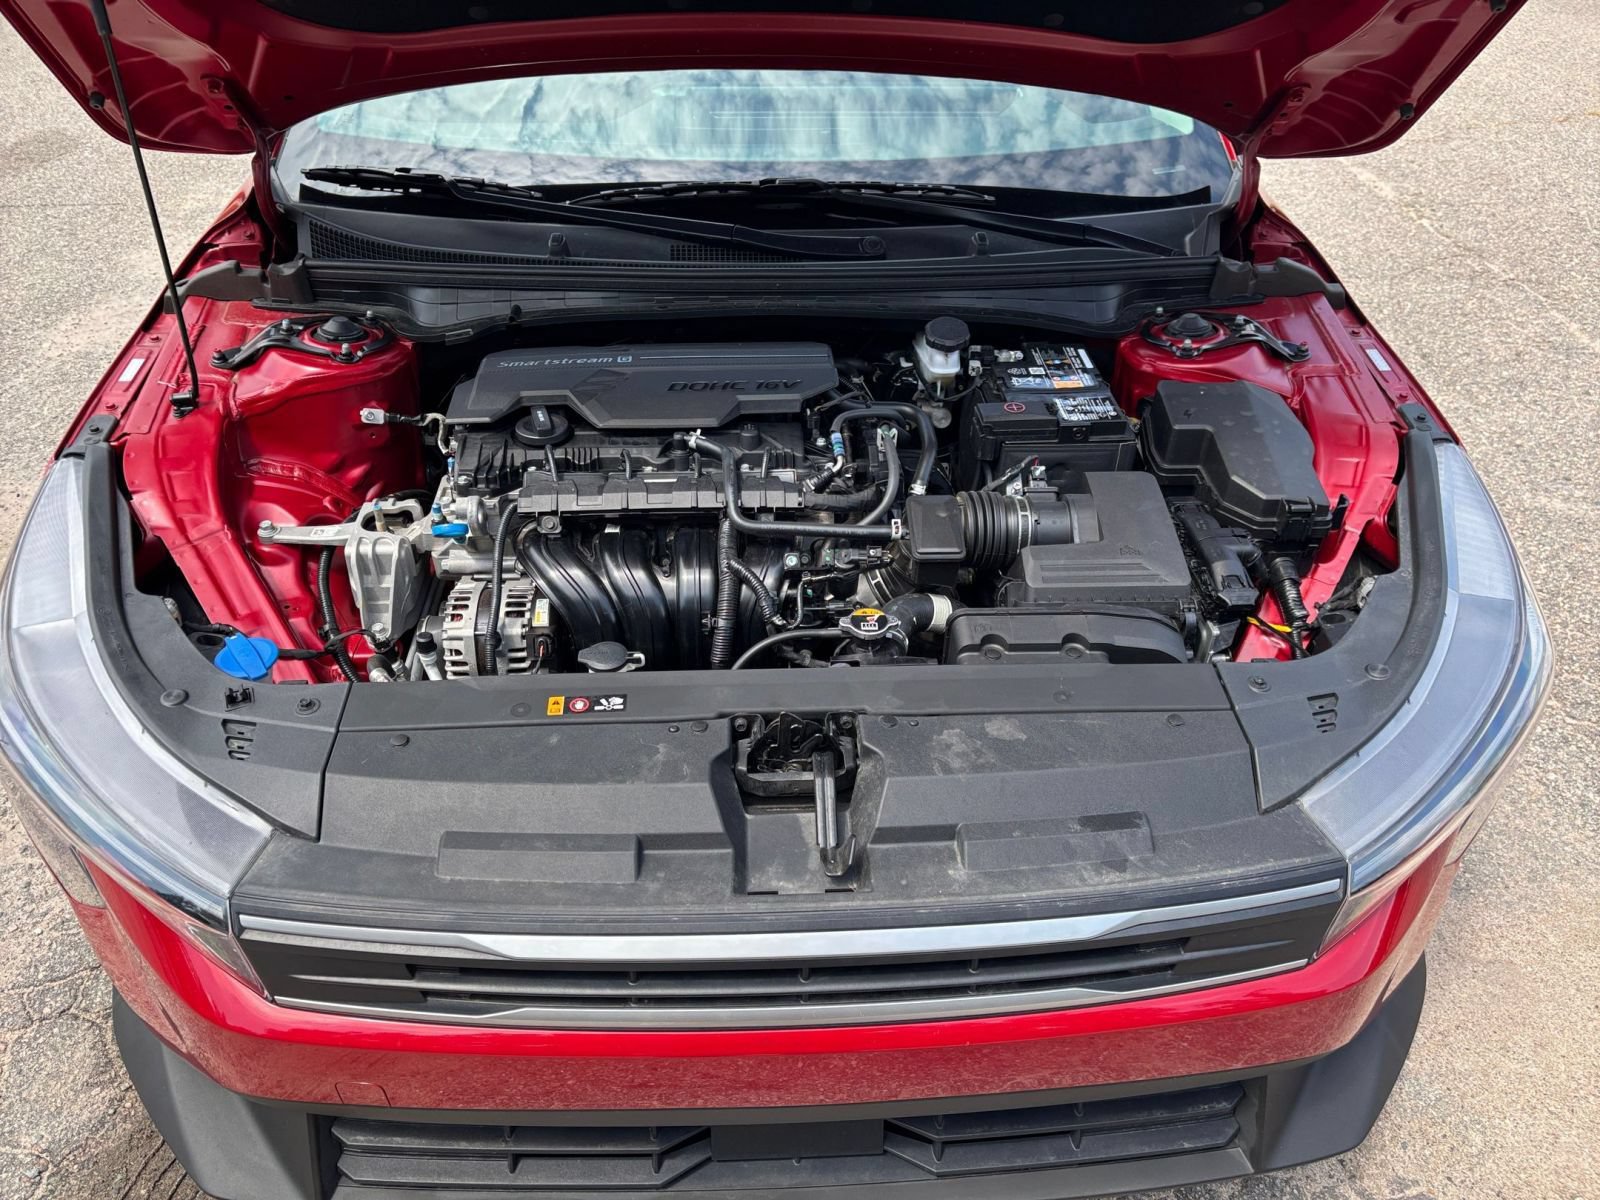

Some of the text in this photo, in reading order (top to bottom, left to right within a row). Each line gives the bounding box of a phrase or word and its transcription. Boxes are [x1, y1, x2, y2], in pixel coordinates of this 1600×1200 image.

[497, 357, 613, 368] Smartstream
[667, 379, 802, 392] DOHC 16V
